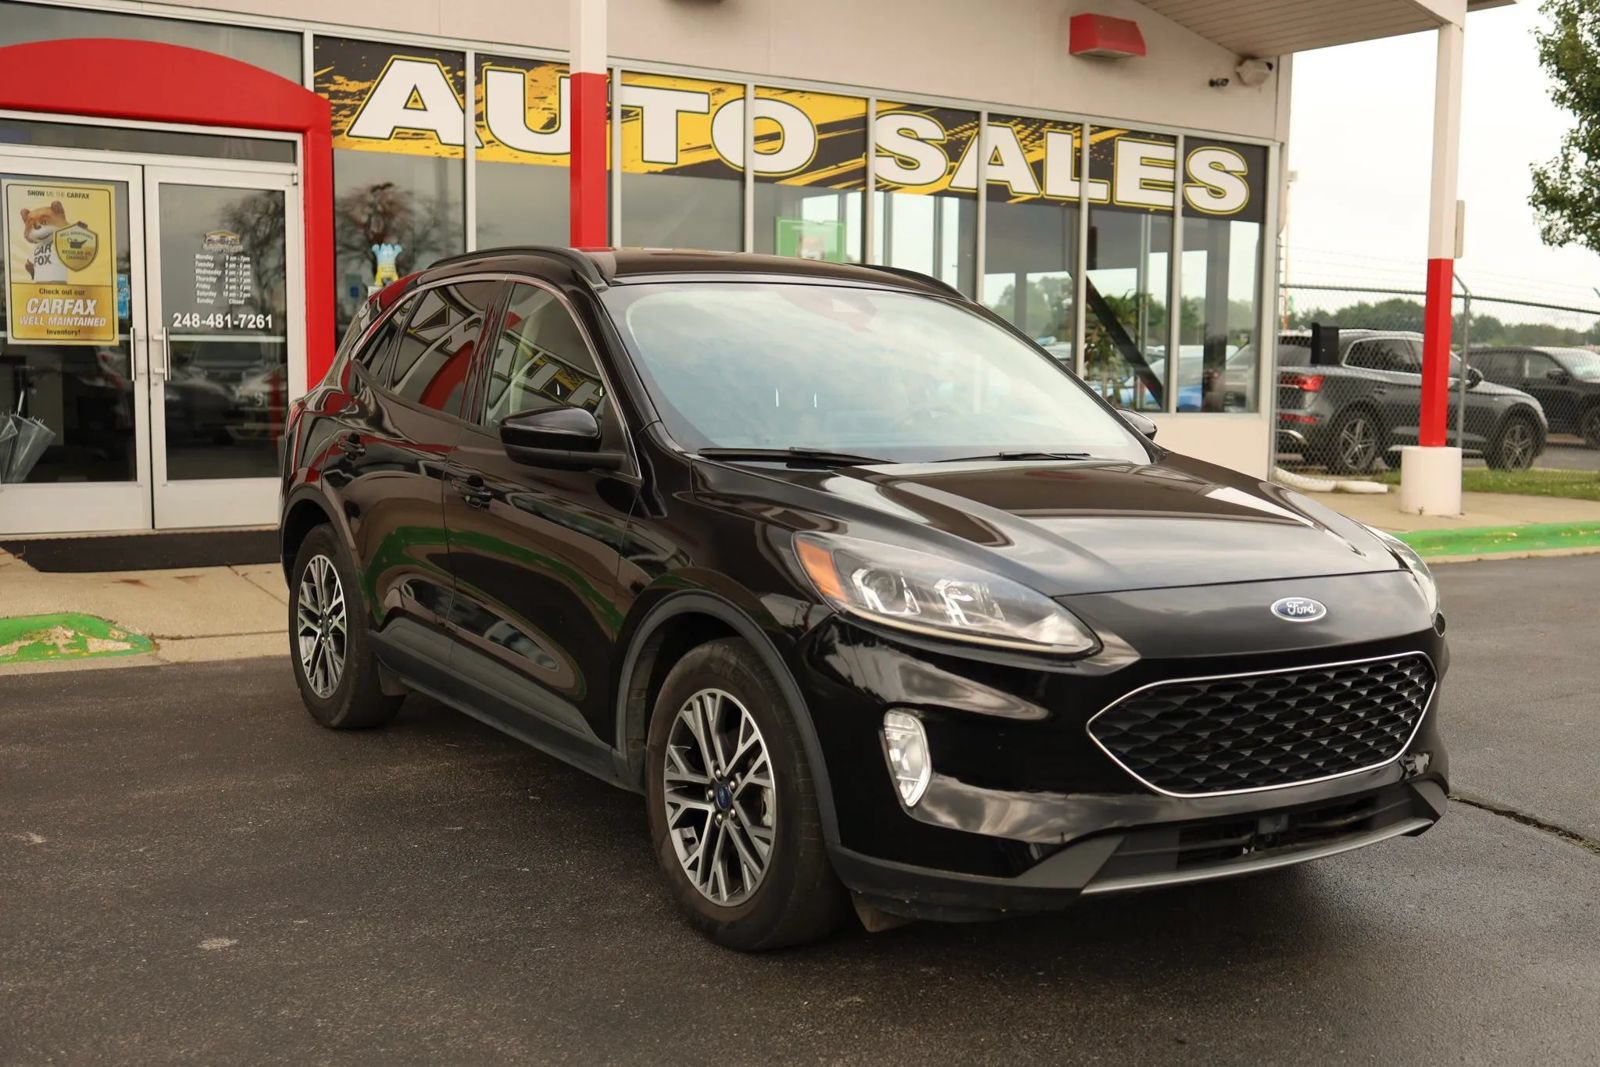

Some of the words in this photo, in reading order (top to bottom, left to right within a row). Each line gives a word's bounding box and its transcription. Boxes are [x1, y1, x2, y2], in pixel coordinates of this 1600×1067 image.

[347, 55, 818, 175] AUTO
[872, 110, 1250, 215] SALES
[27, 189, 45, 197] SHOW
[34, 243, 52, 256] CAR
[34, 255, 52, 267] FOX
[38, 287, 60, 295] Check
[26, 297, 97, 316] CARFAX
[19, 315, 44, 326] WELL
[47, 316, 107, 328] MAINTAINED
[172, 312, 273, 329] 248-481-7261
[1286, 601, 1317, 615] Ford
